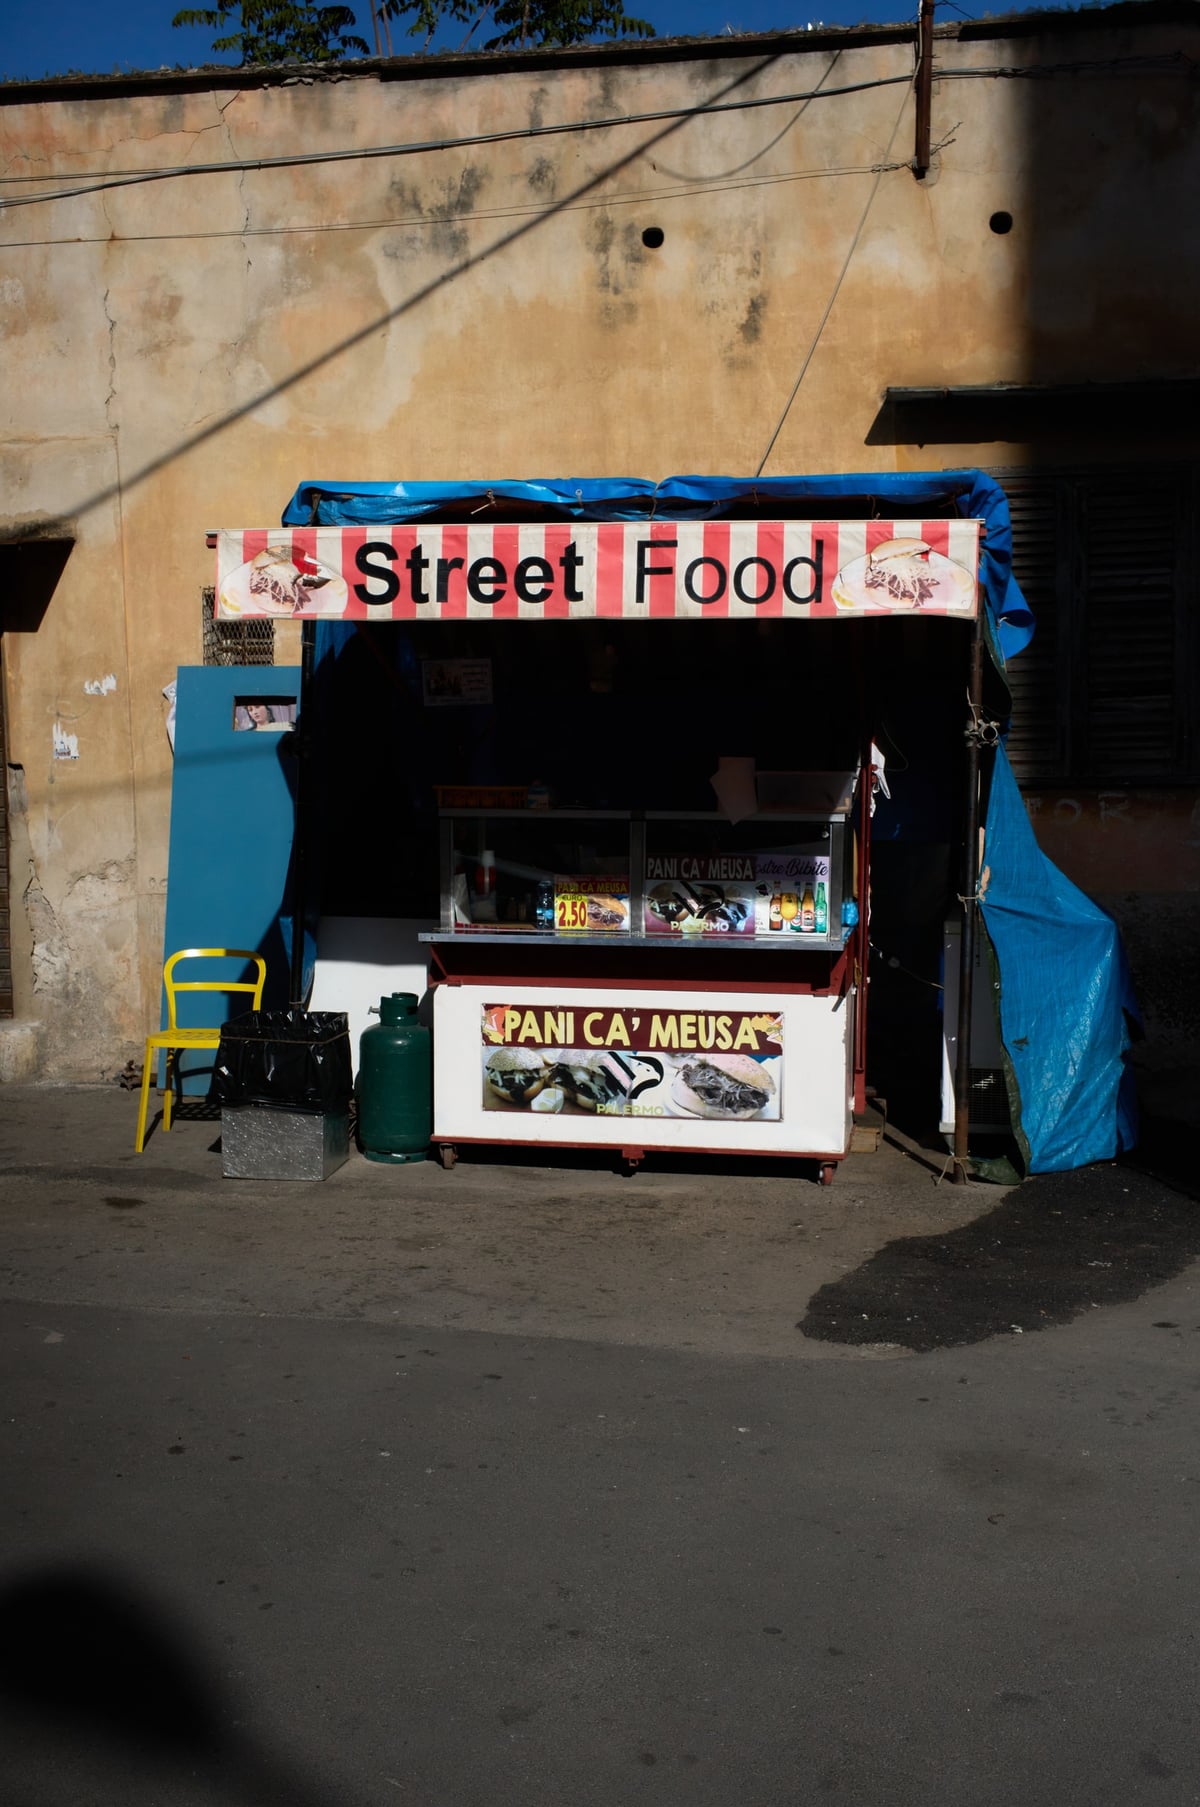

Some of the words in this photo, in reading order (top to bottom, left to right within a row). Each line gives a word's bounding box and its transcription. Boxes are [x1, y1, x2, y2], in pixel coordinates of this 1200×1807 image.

[353, 541, 584, 605] Street
[635, 539, 824, 604] Food
[647, 857, 678, 878] PANI
[708, 858, 753, 880] MEUSA
[785, 858, 829, 877] Bibite
[597, 882, 627, 893] MEUSA
[558, 901, 587, 927] 2.50
[504, 1010, 575, 1044] PANI
[649, 1014, 760, 1051] MEUSA
[596, 1103, 664, 1117] PALERMO
